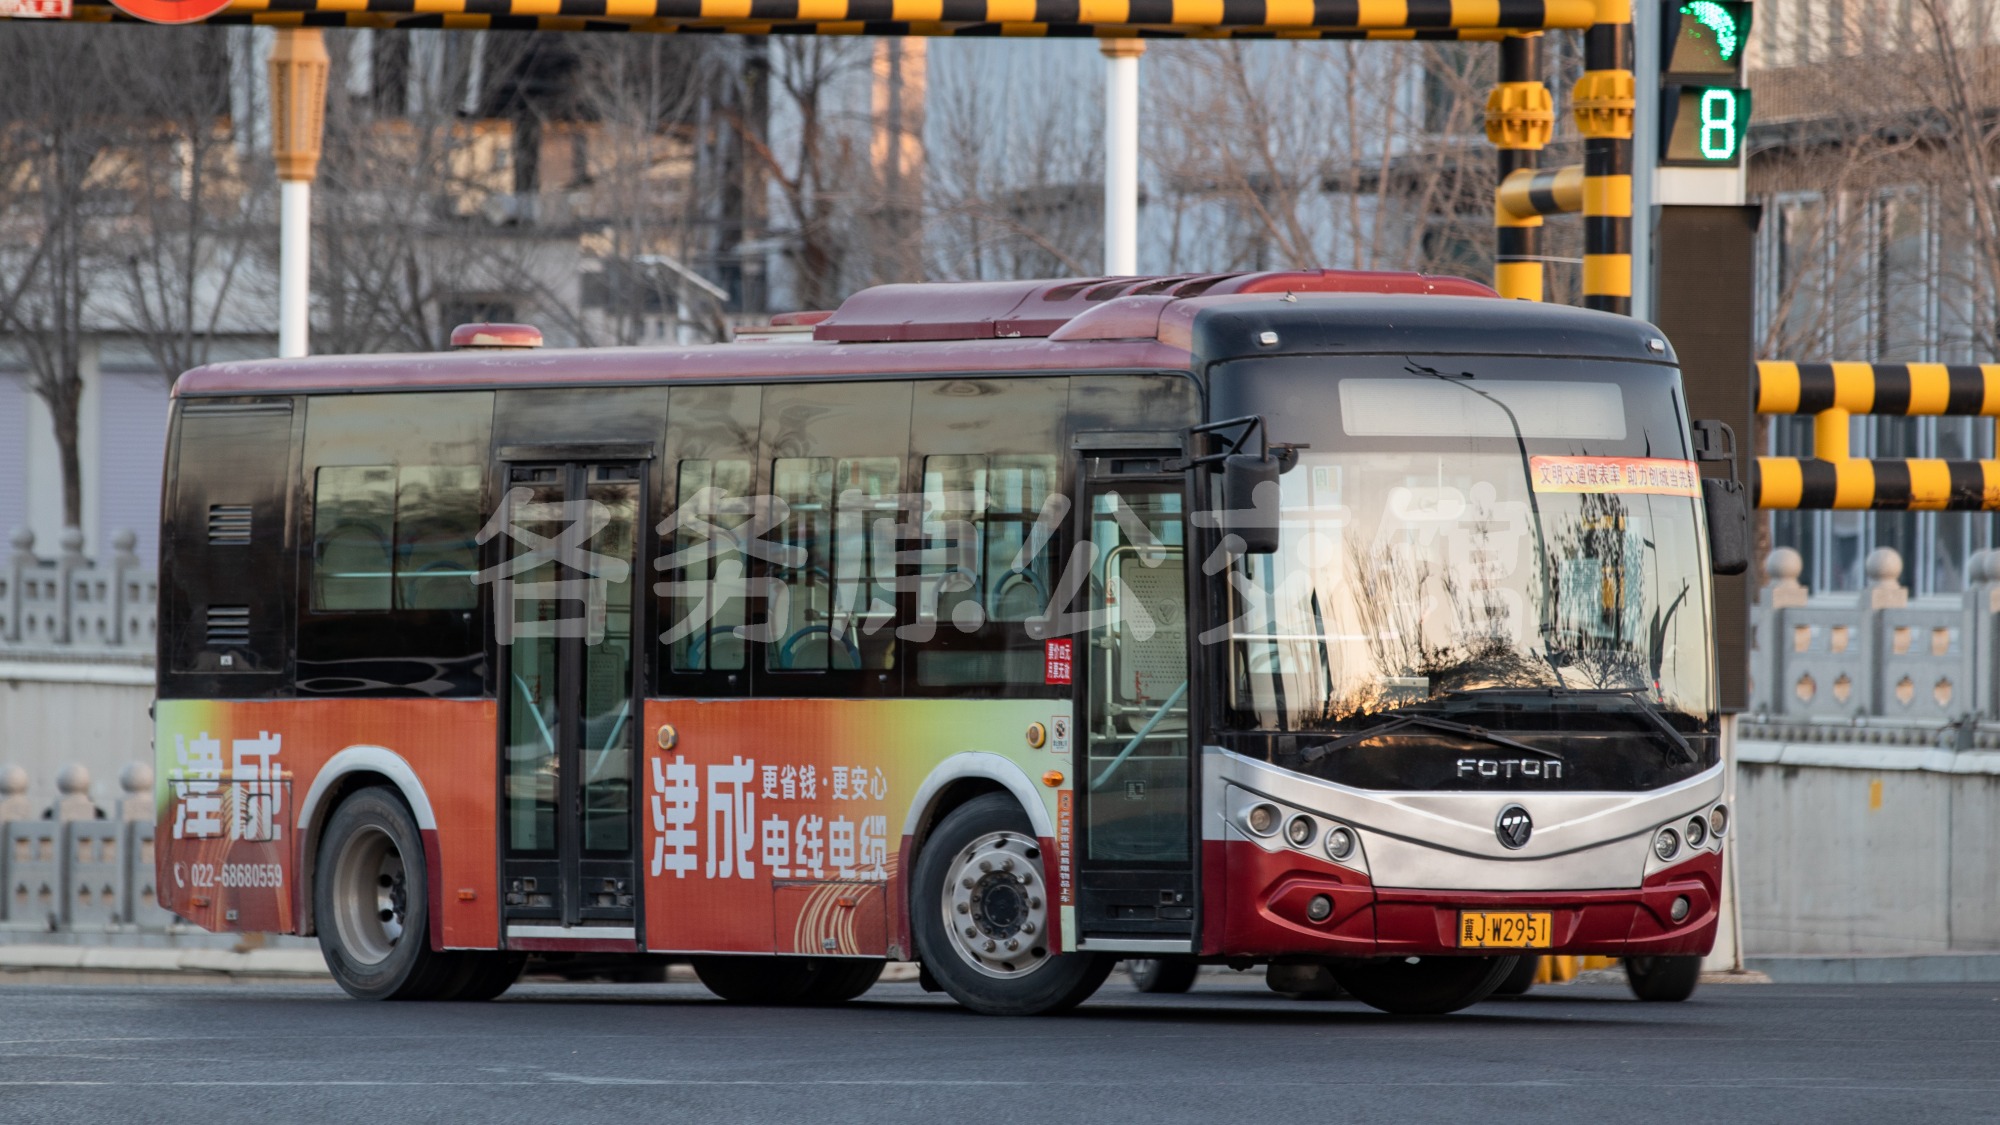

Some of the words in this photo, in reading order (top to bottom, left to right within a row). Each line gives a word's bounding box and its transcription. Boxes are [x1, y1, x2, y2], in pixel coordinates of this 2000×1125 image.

[1701, 89, 1736, 160] 8
[1540, 463, 1620, 485] 文明交通做表率
[173, 731, 282, 841] 津成
[1457, 759, 1562, 778] FOTON
[651, 755, 755, 879] 津成
[762, 814, 888, 881] 电线电缆
[191, 863, 282, 887] 022-68680559
